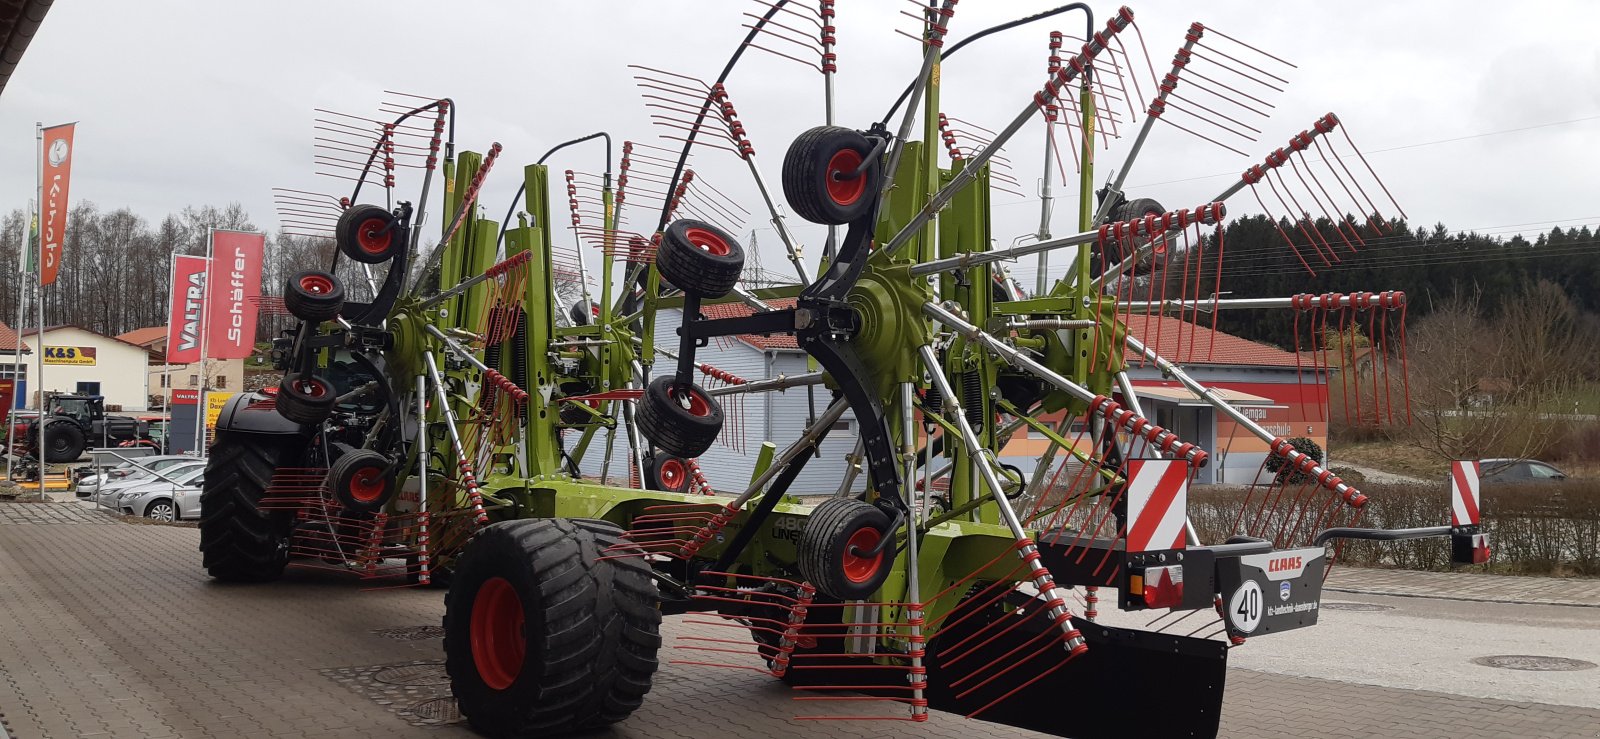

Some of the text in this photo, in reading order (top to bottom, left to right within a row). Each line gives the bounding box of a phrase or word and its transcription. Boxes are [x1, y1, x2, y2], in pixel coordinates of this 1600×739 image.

[228, 247, 245, 347] Schäffer
[178, 271, 206, 352] VALTRA
[45, 347, 75, 358] K&S
[772, 528, 801, 541] LINE
[1268, 556, 1302, 572] CLAAS
[1237, 588, 1258, 622] 40
